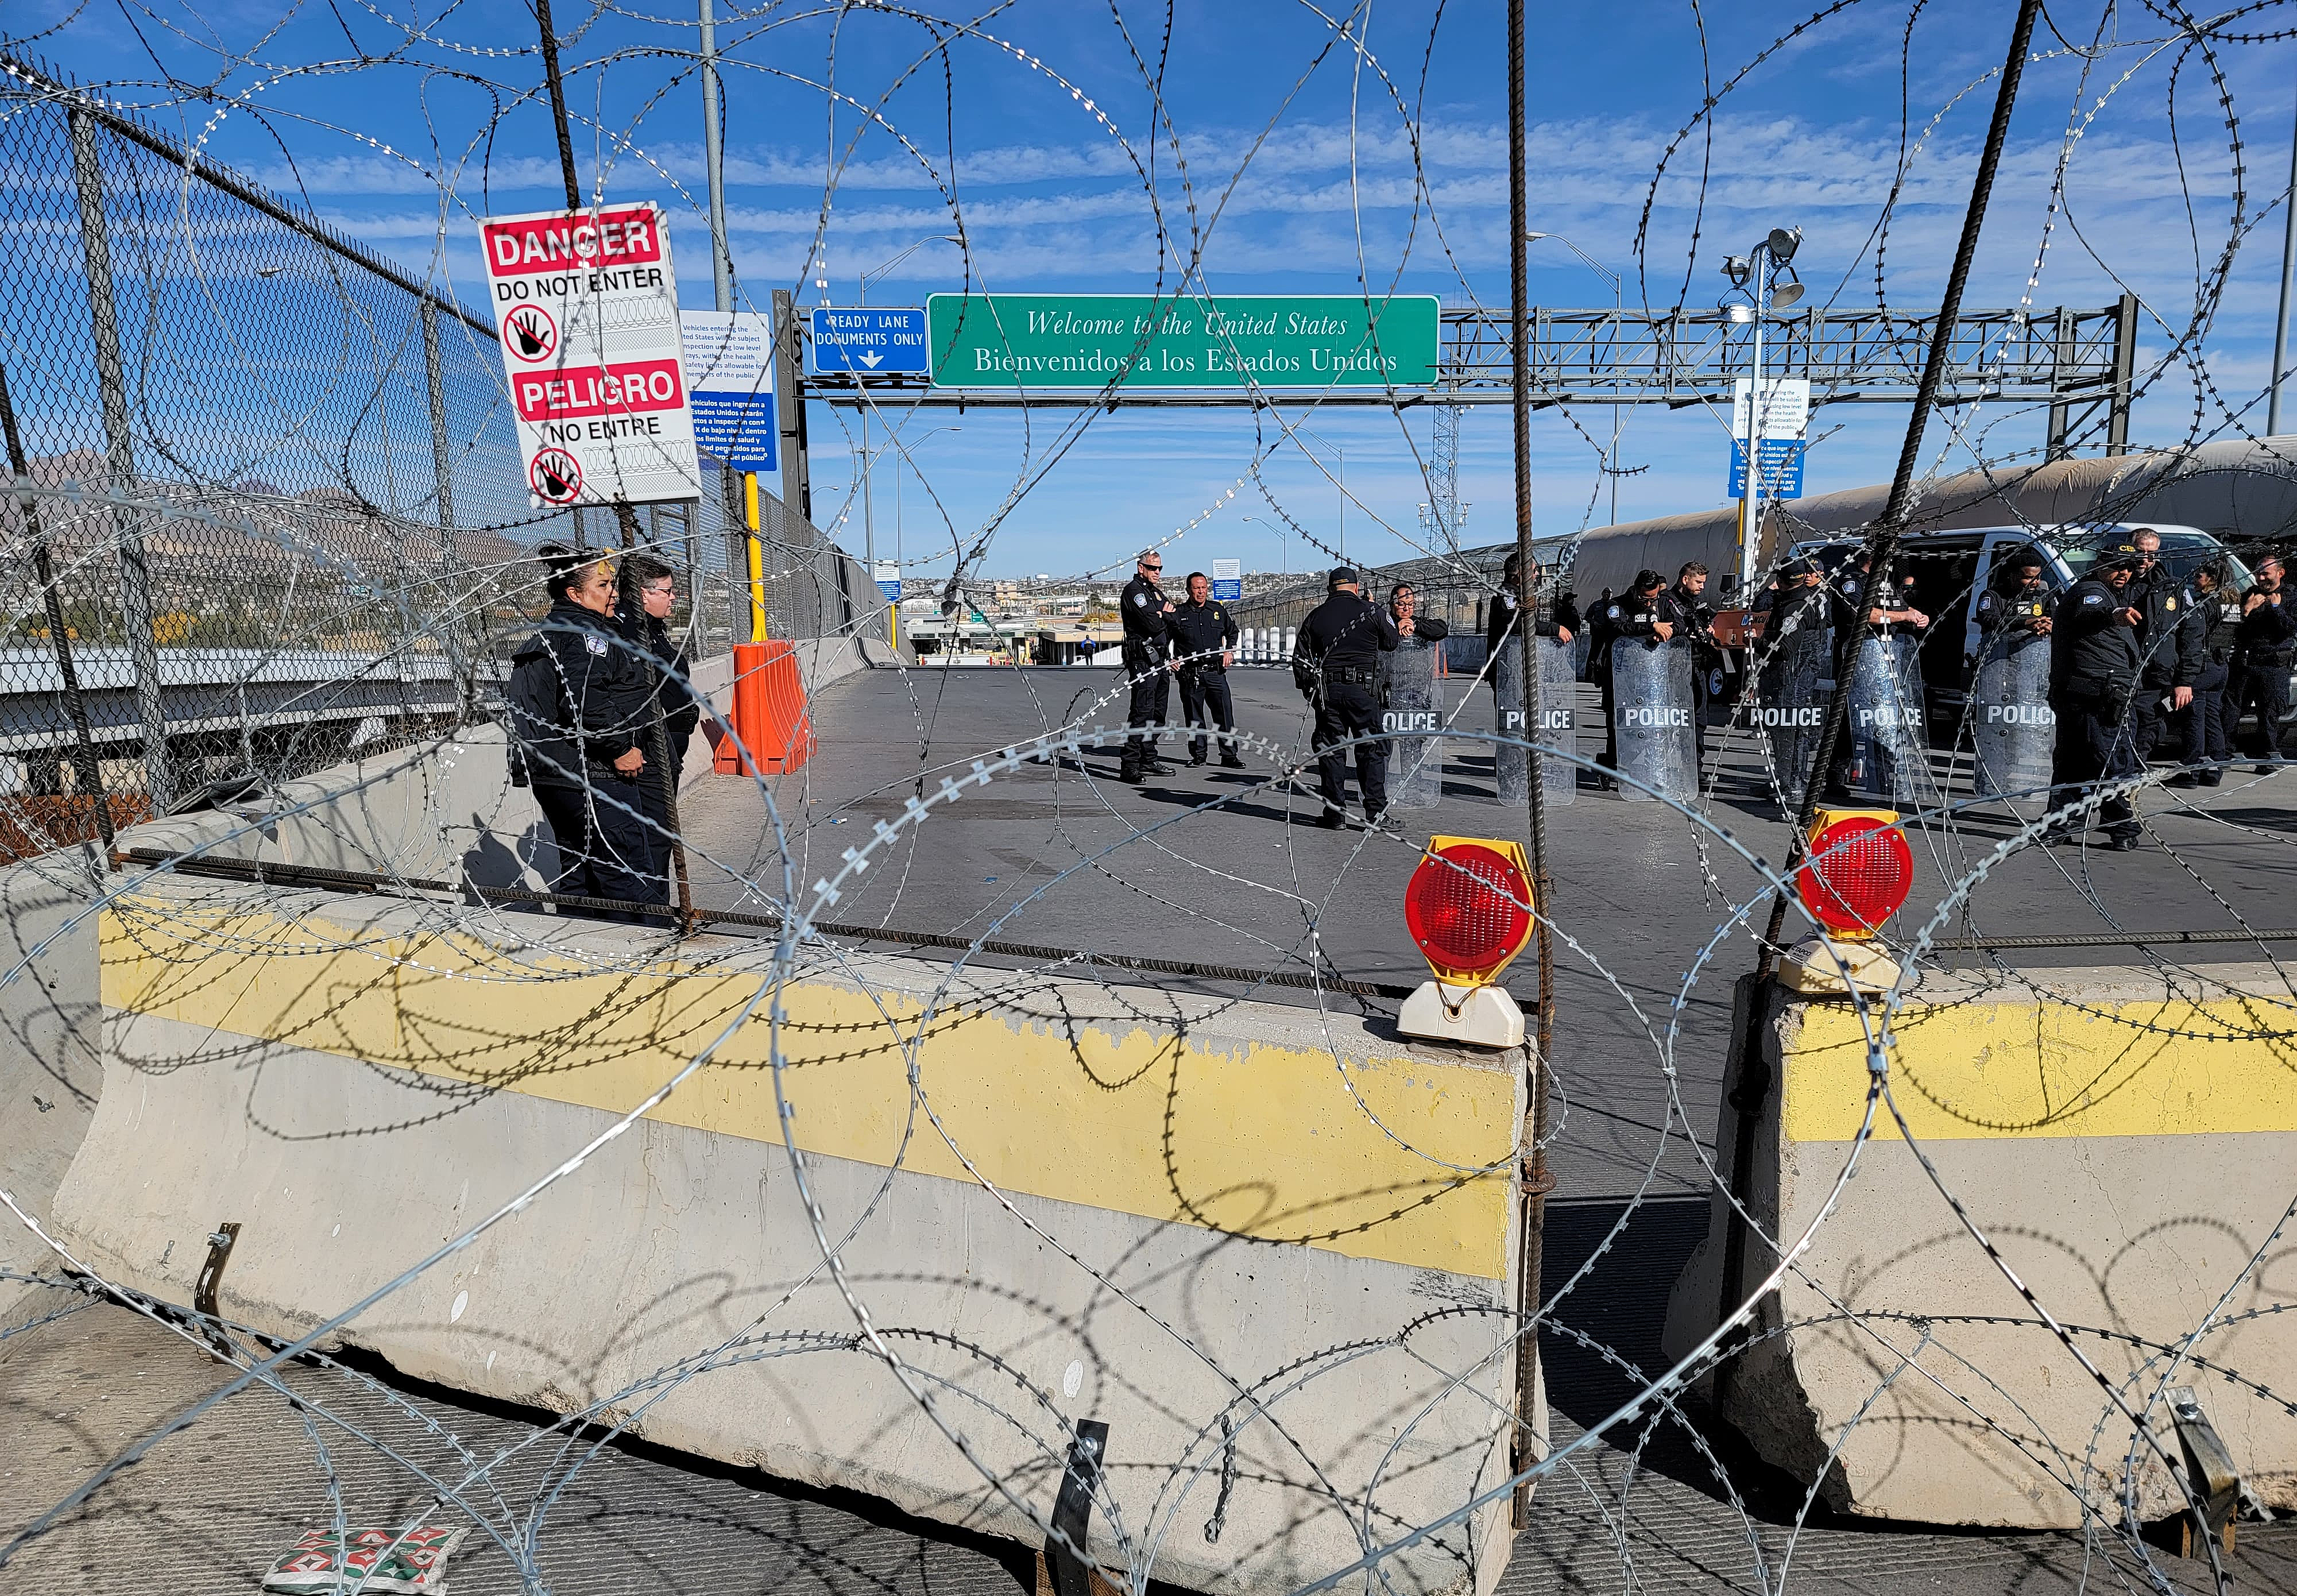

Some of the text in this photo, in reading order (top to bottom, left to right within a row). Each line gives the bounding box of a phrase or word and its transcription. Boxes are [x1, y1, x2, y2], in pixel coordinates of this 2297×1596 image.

[493, 221, 652, 266] DANGER
[497, 268, 664, 301] DO NOT ENTER
[830, 316, 909, 328] READY LANE
[1028, 311, 1348, 336] Welcome to the United States
[817, 333, 923, 345] DOCUMENTS ONLY
[974, 348, 1397, 372] Bienvenidos a los Estados Unidos
[522, 370, 675, 412] PELIGRO
[550, 416, 662, 443] NO ENTRE
[711, 427, 725, 435] bajo
[1382, 712, 1436, 732] OLICE
[1625, 708, 1690, 728] POLICE
[1750, 708, 1822, 726] POLICE
